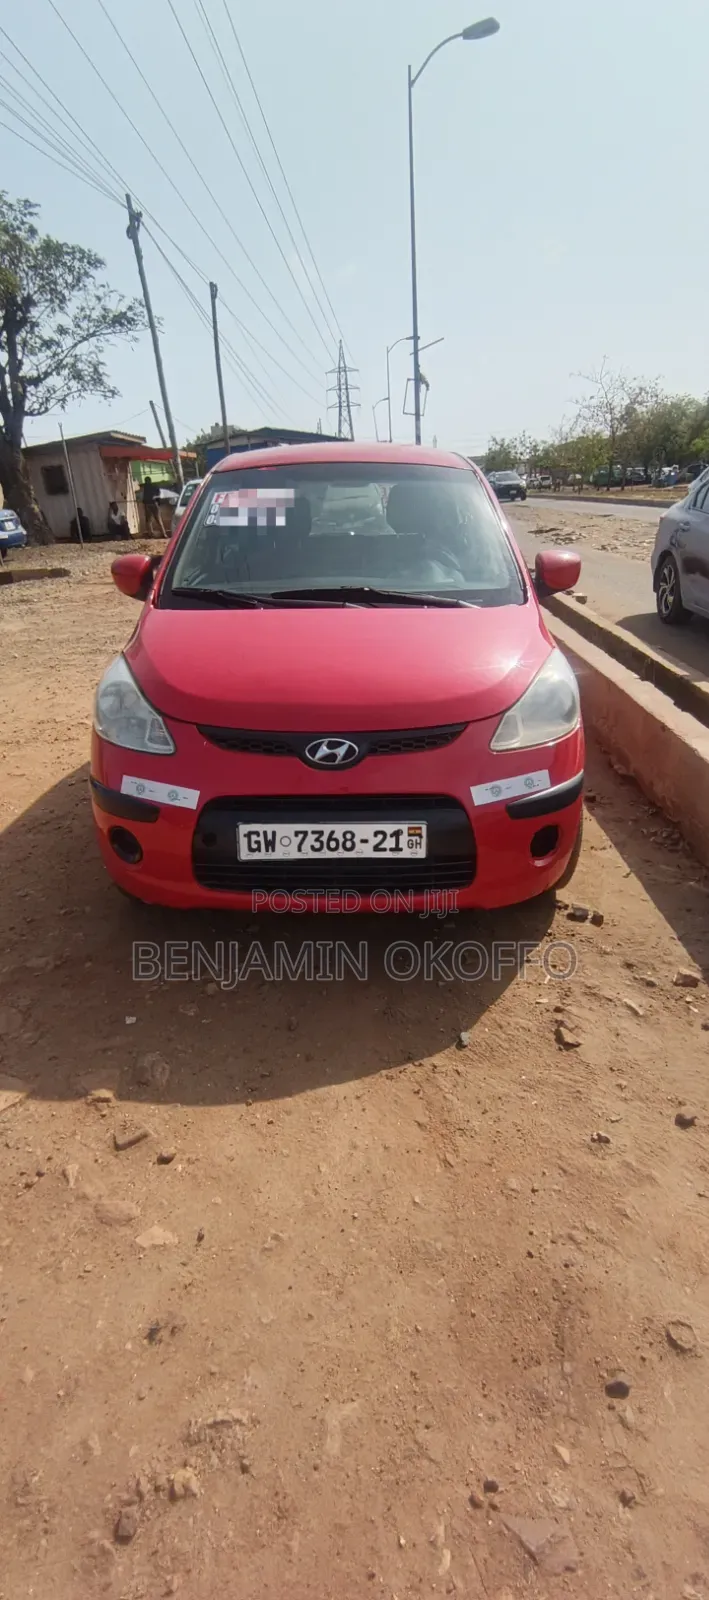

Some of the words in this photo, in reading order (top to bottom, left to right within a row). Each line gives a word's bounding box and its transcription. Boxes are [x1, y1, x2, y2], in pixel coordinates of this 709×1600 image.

[246, 830, 277, 853] GW
[293, 829, 404, 852] 7368-21
[407, 838, 422, 849] GH
